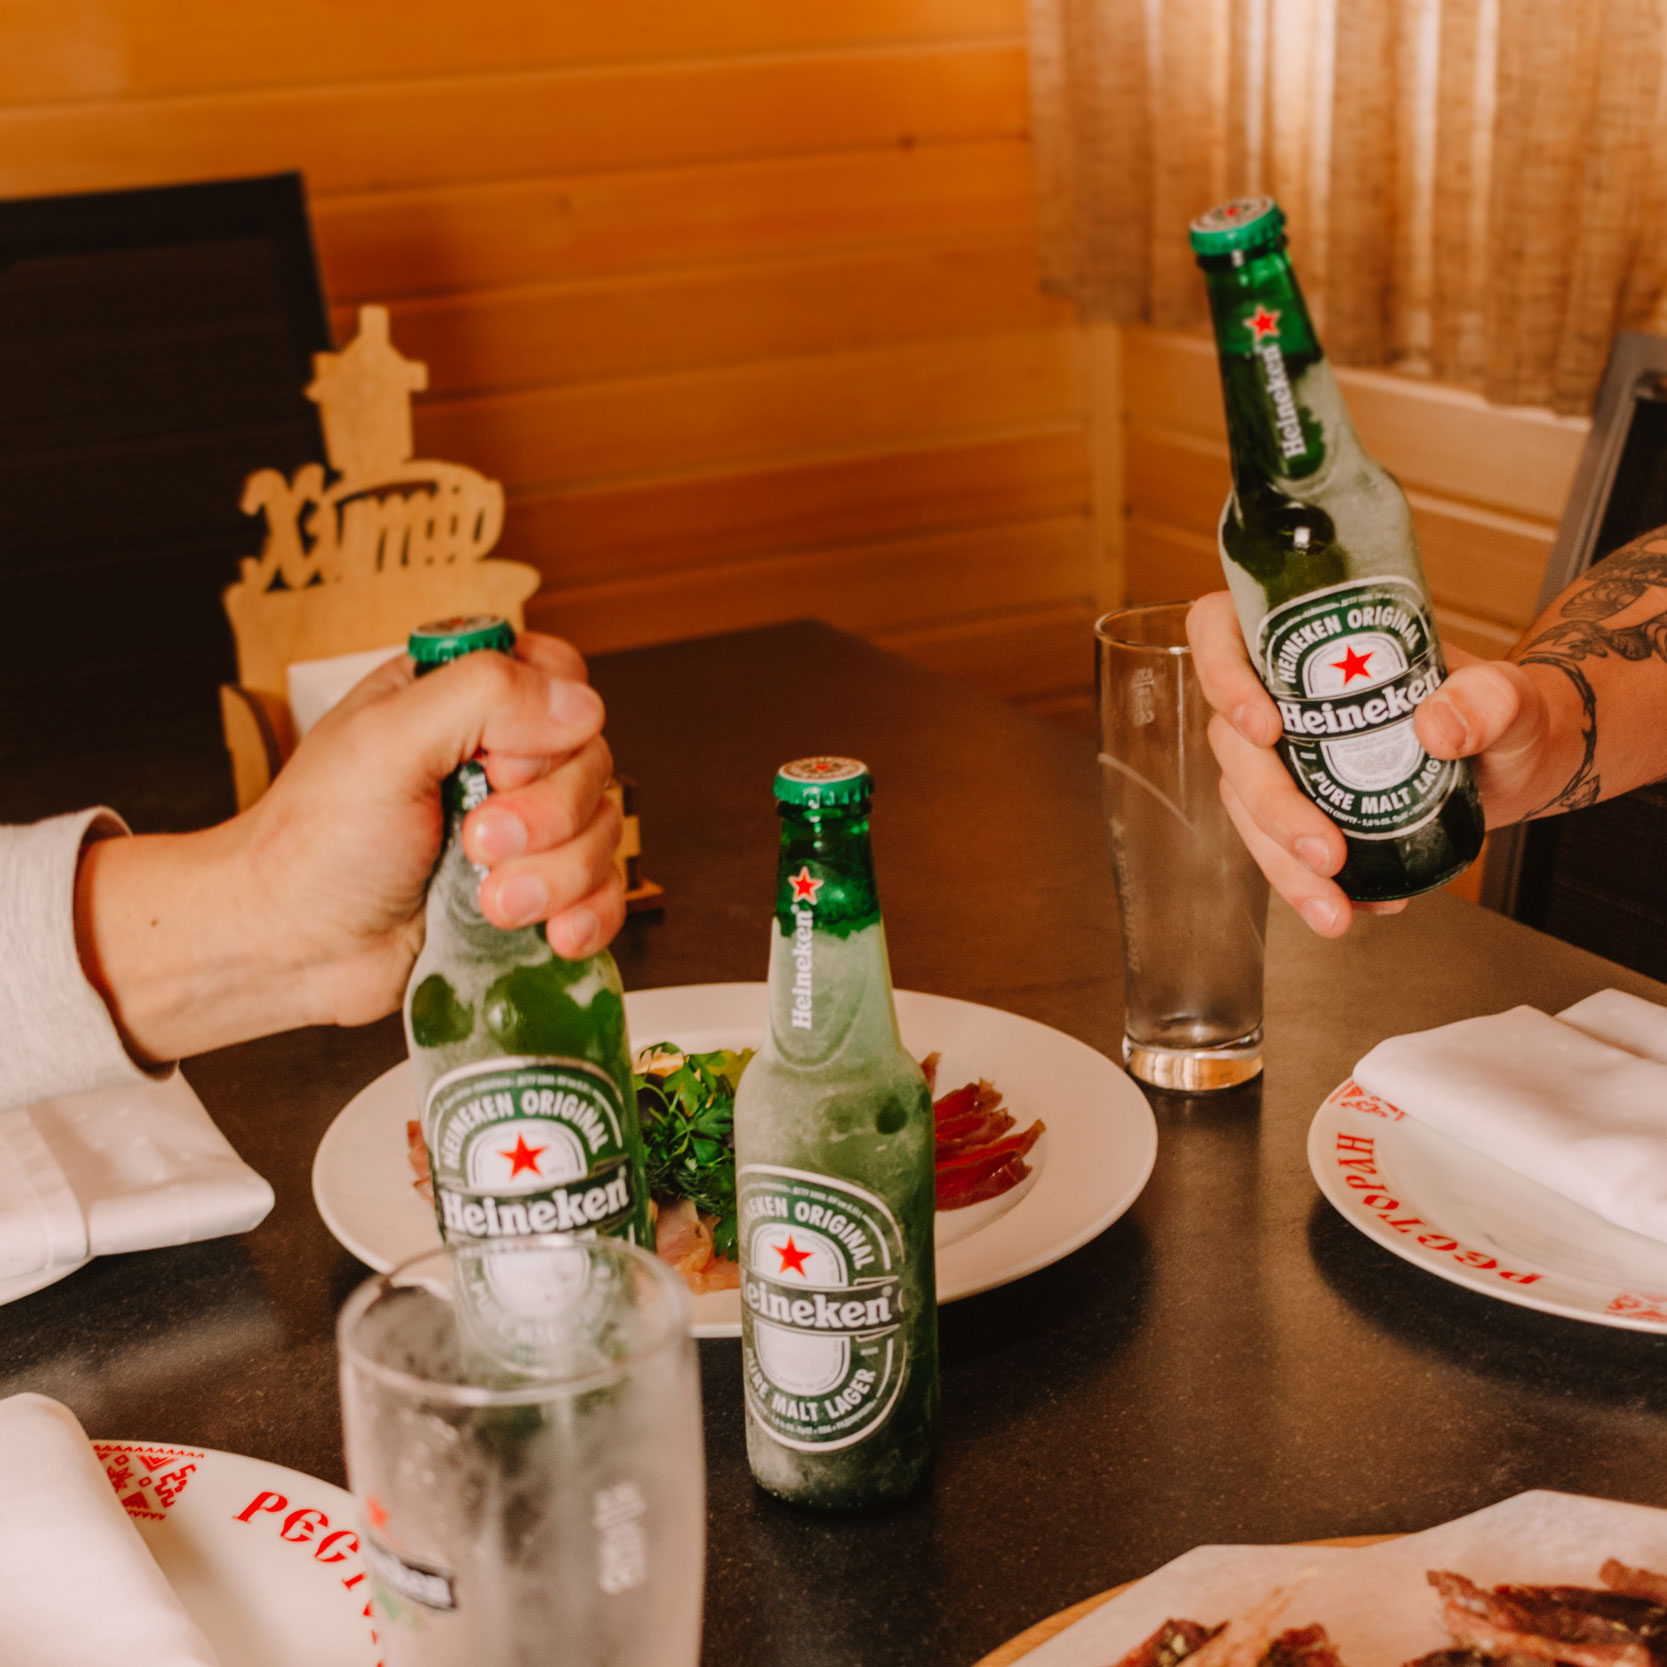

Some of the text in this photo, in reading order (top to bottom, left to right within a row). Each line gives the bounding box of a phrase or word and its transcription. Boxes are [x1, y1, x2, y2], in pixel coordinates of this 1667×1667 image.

[1262, 343, 1307, 459] Heineken
[1278, 615, 1343, 684] HEINEKEN
[1347, 606, 1420, 650] ORIGINAL
[1277, 667, 1442, 735] Heineken
[1309, 771, 1355, 810] PURE
[1361, 787, 1412, 814] MALT
[1412, 755, 1441, 795] LAG
[791, 909, 813, 1030] Heineken
[443, 1091, 515, 1170] HEINEKEN
[521, 1089, 609, 1155] ORIGINAL
[438, 1178, 630, 1236] Heineken
[794, 1201, 875, 1271] ORIGINAL
[744, 1281, 893, 1330] eineken
[771, 1392, 819, 1423] MALT
[824, 1368, 877, 1418] LAGER
